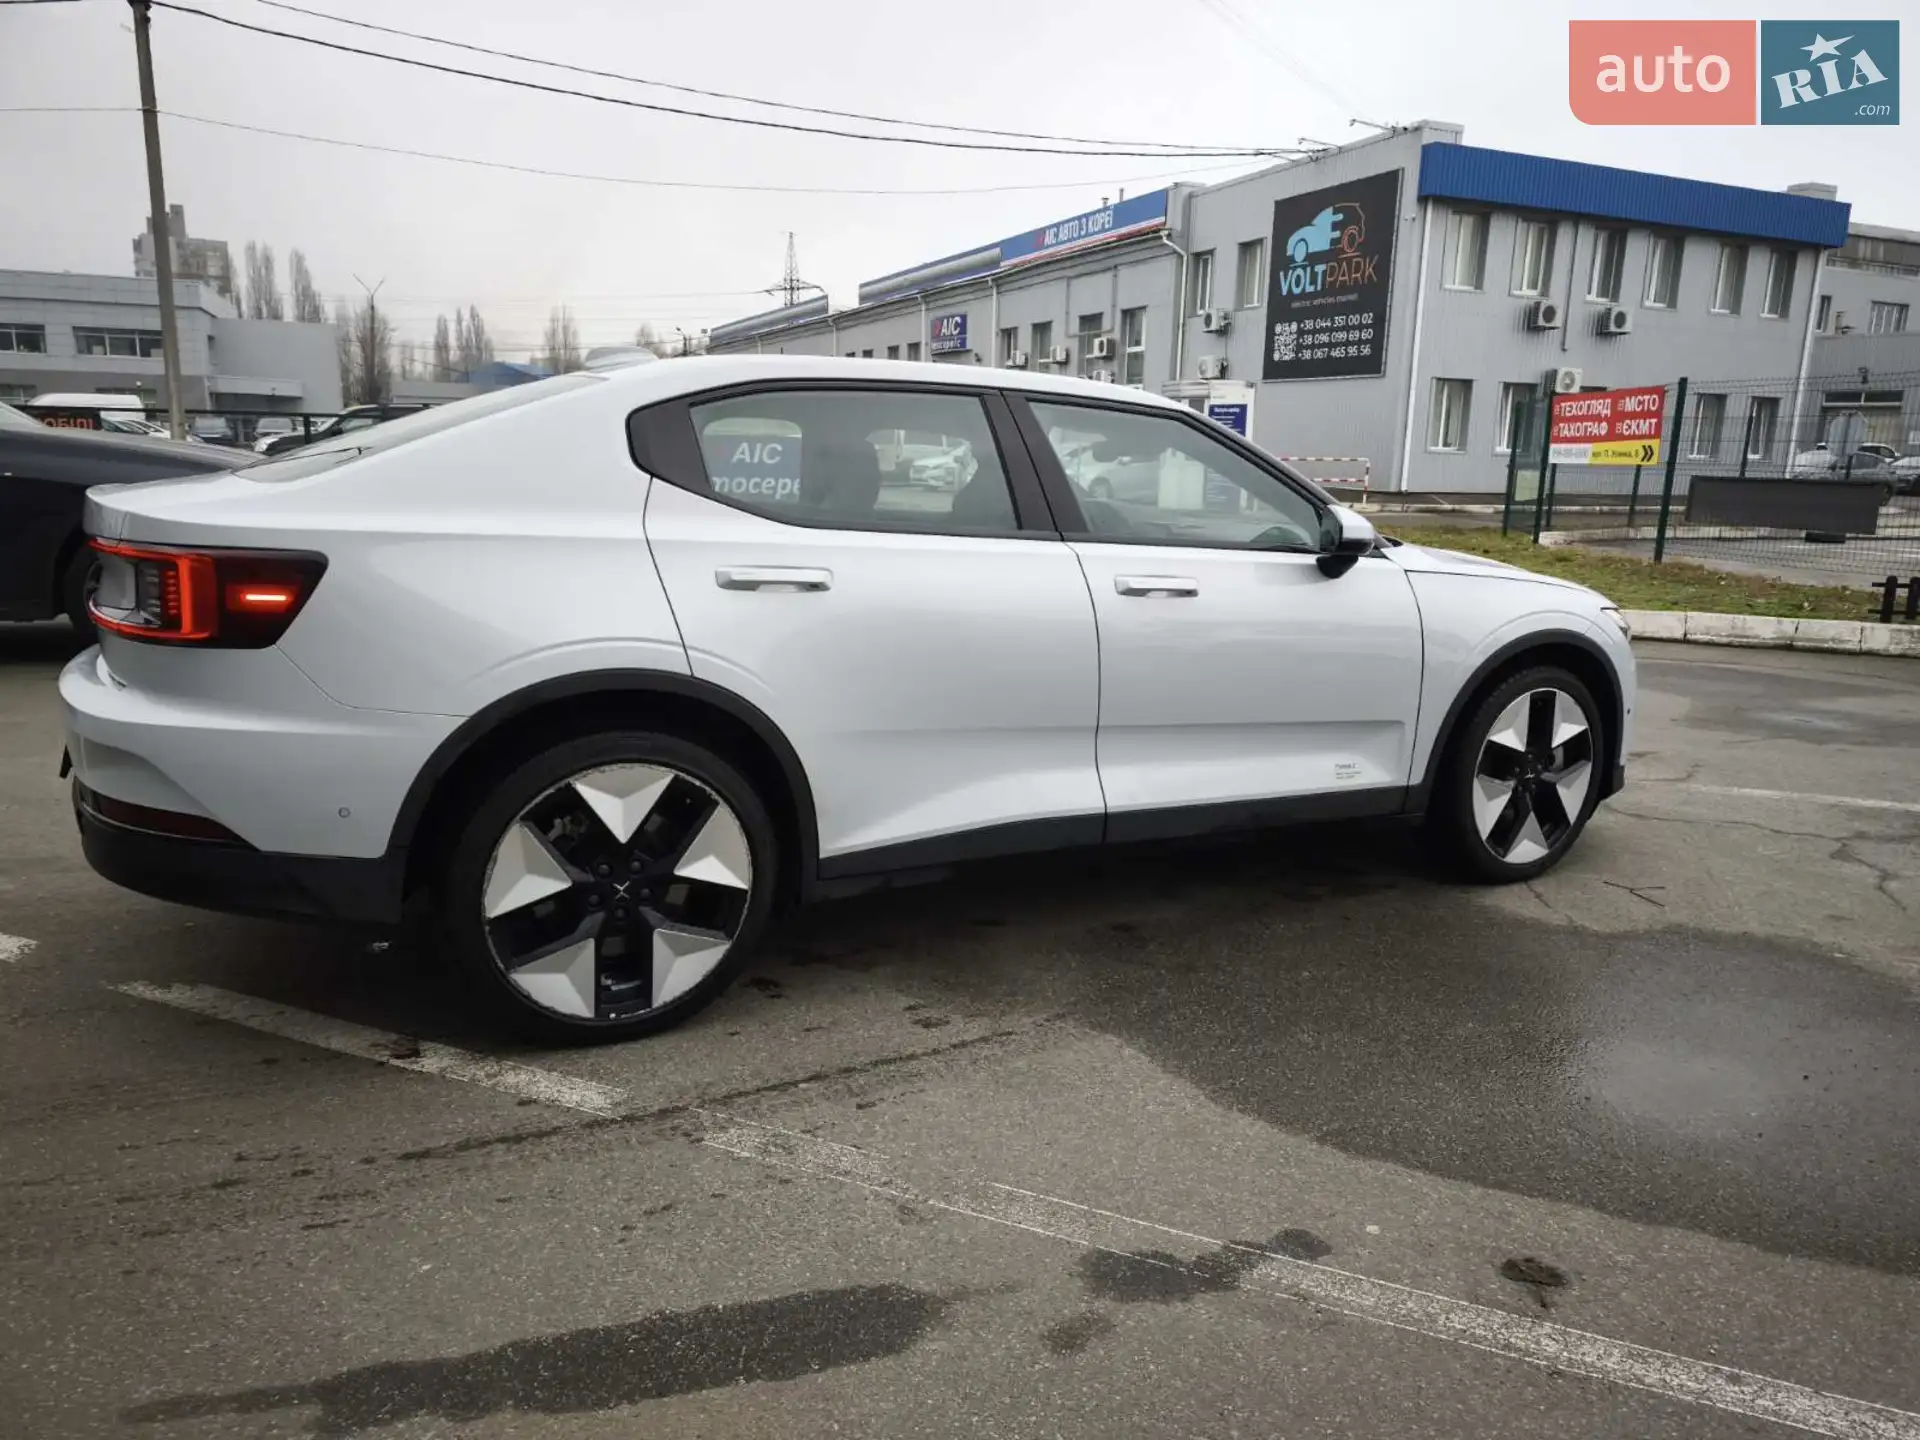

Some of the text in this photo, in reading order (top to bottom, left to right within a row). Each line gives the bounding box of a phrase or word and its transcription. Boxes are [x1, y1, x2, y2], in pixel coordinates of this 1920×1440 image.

[1058, 219, 1079, 242] АВТО
[1280, 254, 1379, 296] VOLTPARK
[1315, 318, 1331, 329] 044
[1333, 316, 1347, 327] 351
[1348, 314, 1360, 326] 00
[1362, 312, 1373, 324] 02
[1560, 399, 1611, 418] ТЕХОГЛЯД
[1624, 395, 1659, 412] МСТО
[1559, 421, 1608, 437] ТАХОГРАФ
[1623, 419, 1658, 436] ЄКМТ
